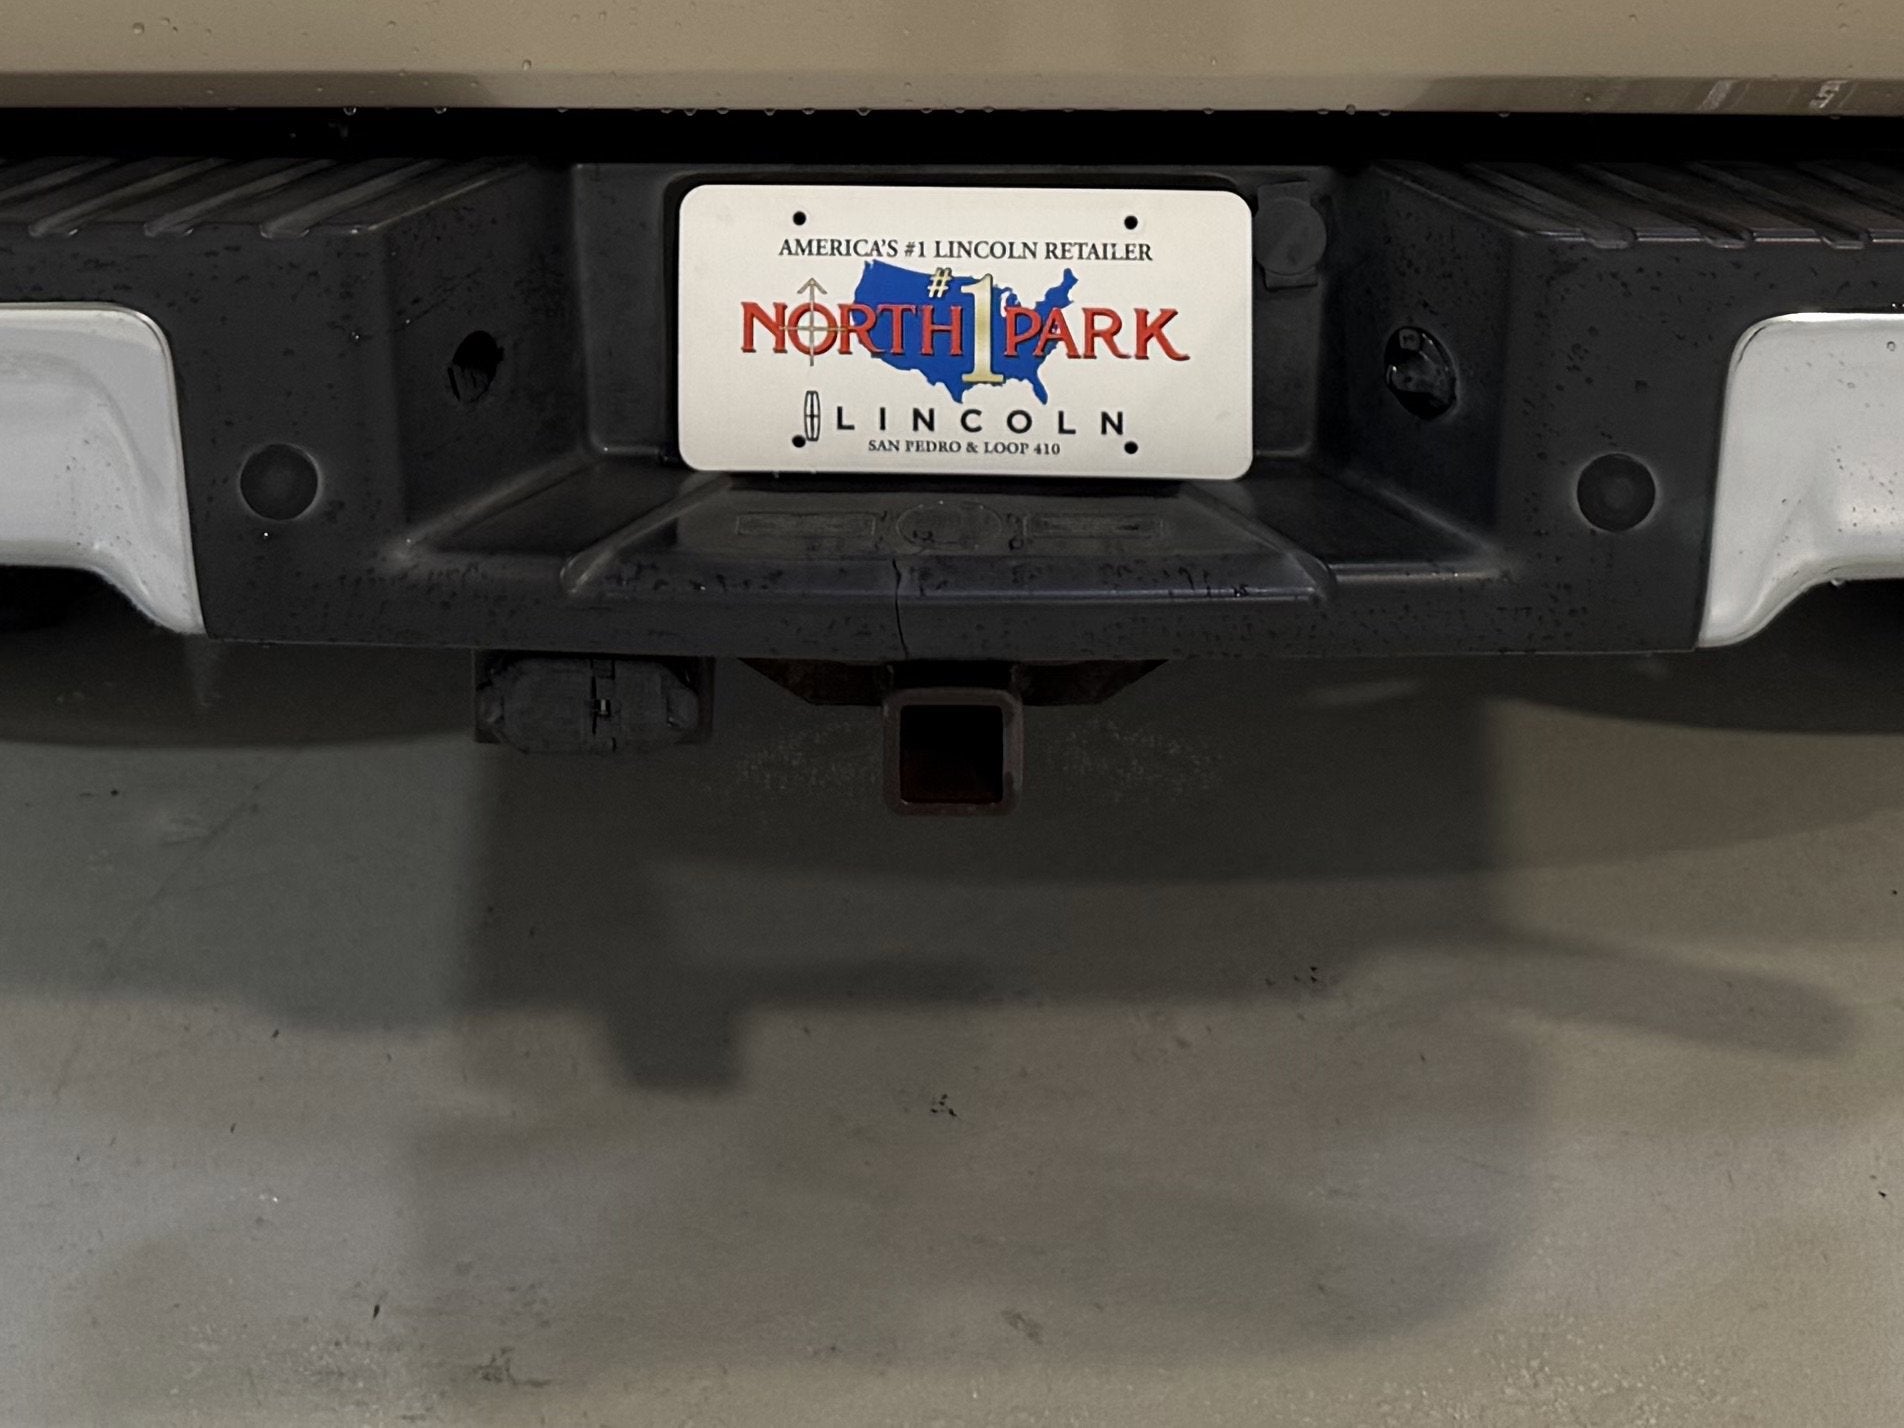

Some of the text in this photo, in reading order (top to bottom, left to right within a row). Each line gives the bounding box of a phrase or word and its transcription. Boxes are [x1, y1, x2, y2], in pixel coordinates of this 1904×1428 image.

[778, 238, 1153, 262] AMERICA'S #1 LINCOLN RETAILER
[741, 301, 1190, 361] NORTH PARK
[837, 406, 1124, 436] LINCOLN
[868, 440, 1060, 455] SAN PEDRO & LOOP 410
